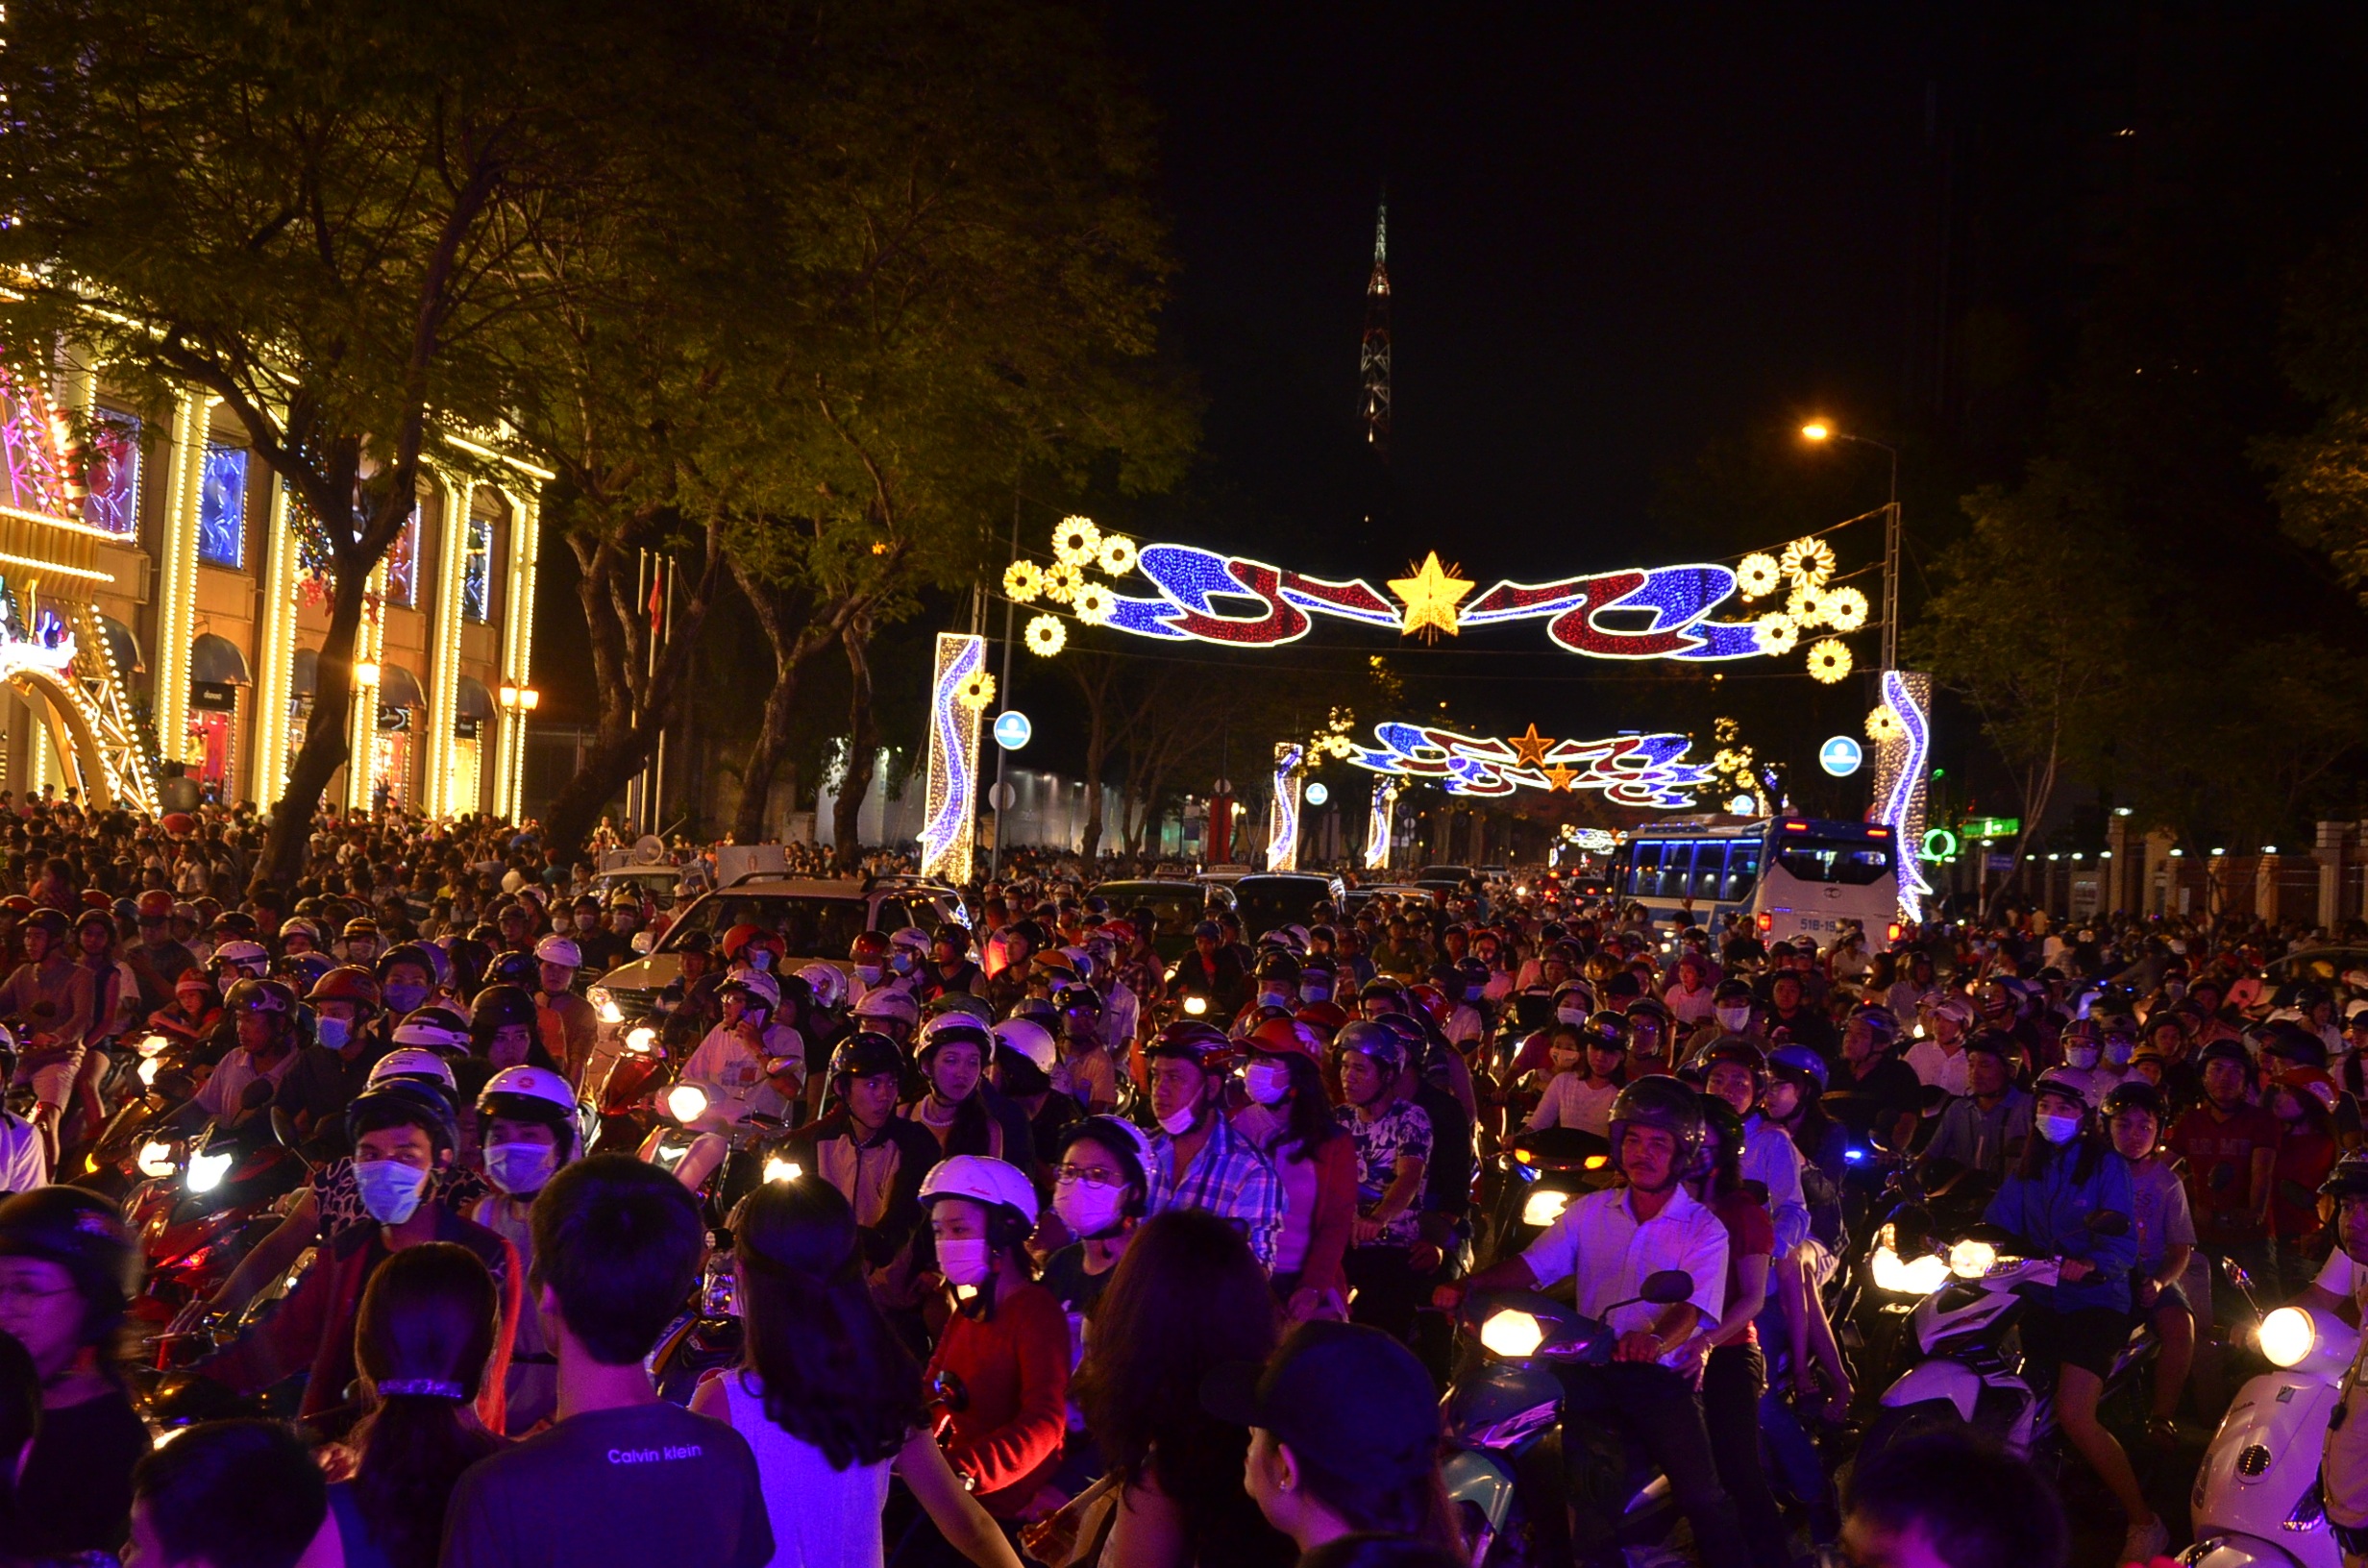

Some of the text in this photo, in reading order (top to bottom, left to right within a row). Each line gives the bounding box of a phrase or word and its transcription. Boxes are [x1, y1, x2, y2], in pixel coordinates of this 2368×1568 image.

[1800, 918, 1837, 932] 51B-19
[607, 1443, 703, 1463] Calvin klein
